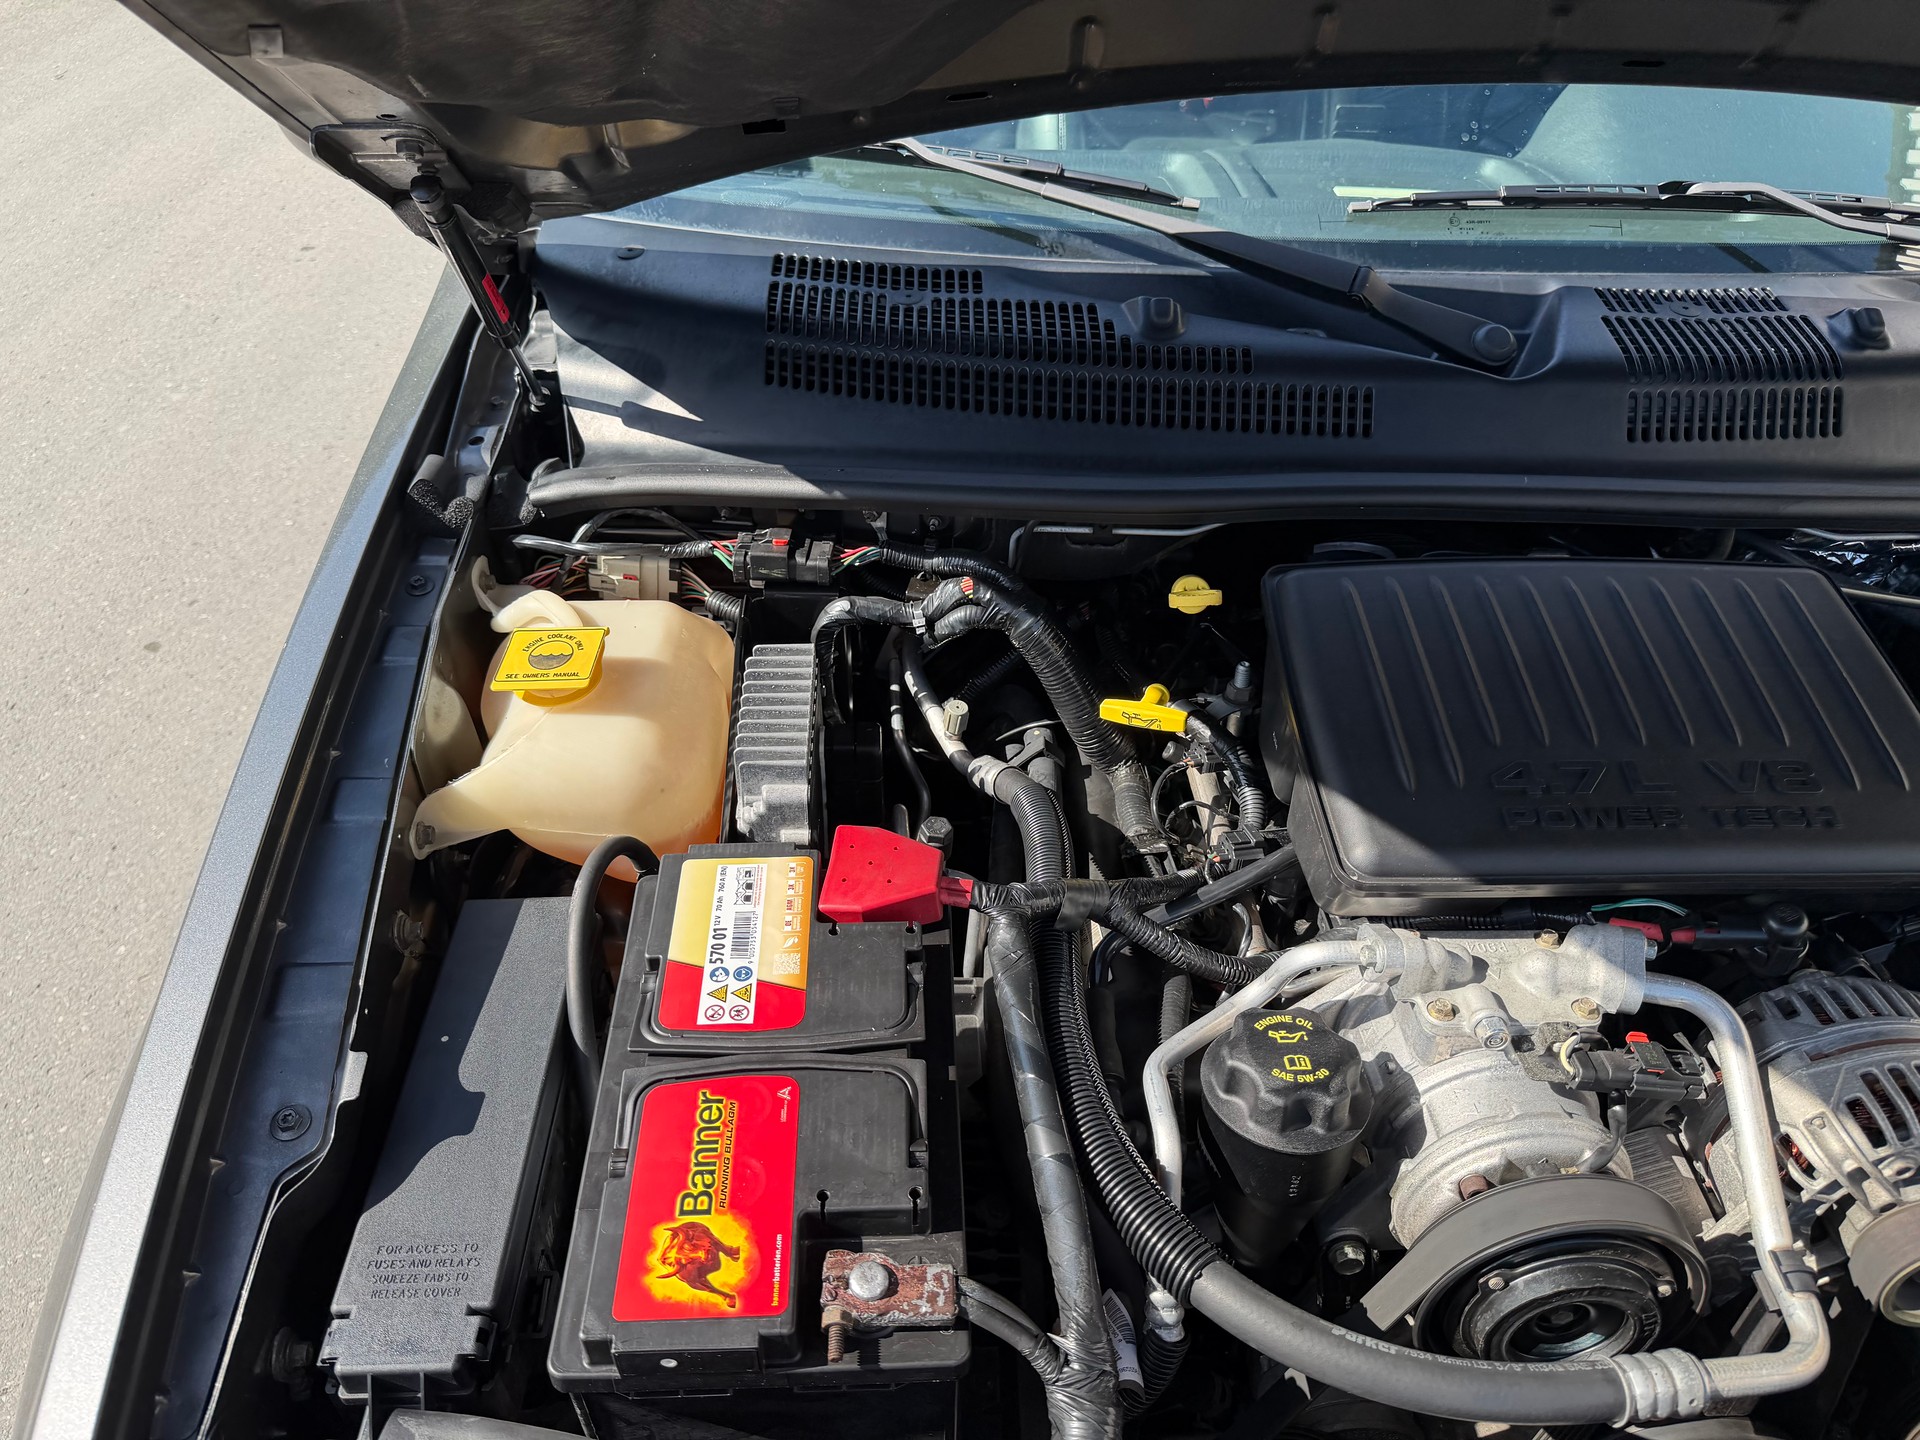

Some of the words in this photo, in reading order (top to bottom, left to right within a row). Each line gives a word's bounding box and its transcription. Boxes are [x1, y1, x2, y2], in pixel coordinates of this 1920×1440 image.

[522, 637, 544, 652] ENGINE
[547, 633, 577, 641] COOLANT
[1702, 758, 1824, 794] V8
[1503, 804, 1688, 830] POWER
[1705, 804, 1843, 830] TECH
[720, 866, 728, 877] (EN)
[716, 904, 723, 912] 70
[712, 927, 728, 940] 01
[709, 943, 726, 964] 570
[1254, 1015, 1293, 1031] ENGINE
[1295, 1017, 1314, 1030] OIL
[1271, 1068, 1294, 1082] SAE
[1297, 1068, 1329, 1083] 5W-30
[728, 1101, 736, 1126] AGM
[725, 1127, 734, 1154] BULL
[677, 1090, 725, 1217] Banner
[719, 1156, 730, 1209] RUNNING
[376, 1245, 403, 1254] FOR
[405, 1244, 458, 1254] ACCESS
[463, 1243, 479, 1252] TO
[367, 1260, 405, 1269] FUSES
[408, 1259, 432, 1268] AND
[434, 1258, 481, 1267] RELAYS
[771, 1234, 782, 1306] bannerbatterien.com
[371, 1274, 421, 1284] SQUEEZE
[424, 1273, 451, 1282] TABS
[455, 1272, 469, 1281] TO
[370, 1289, 422, 1299] RELEASE
[424, 1287, 461, 1297] COVER
[1331, 1326, 1398, 1355] Parker
